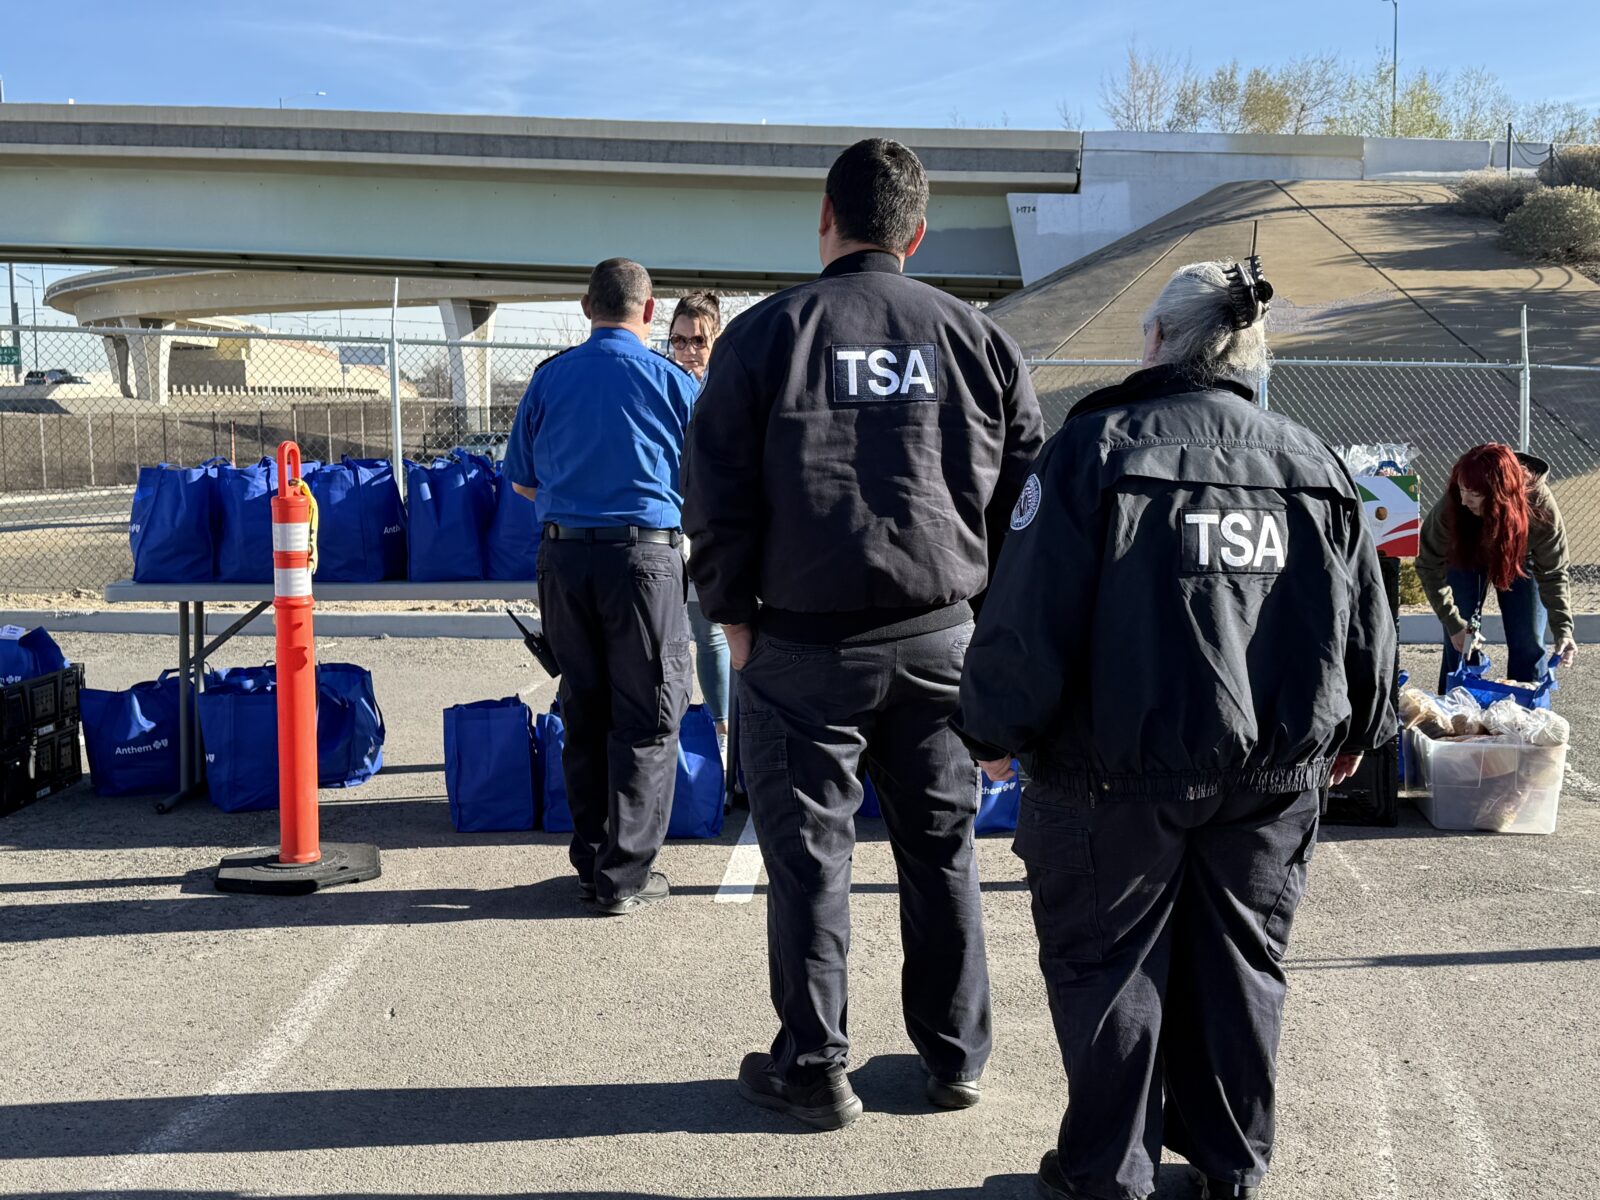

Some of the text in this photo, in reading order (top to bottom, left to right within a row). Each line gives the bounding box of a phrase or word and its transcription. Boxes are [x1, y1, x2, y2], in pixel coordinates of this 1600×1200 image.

[836, 349, 935, 396] TSA
[1185, 513, 1286, 568] TSA
[115, 744, 152, 755] Anthem
